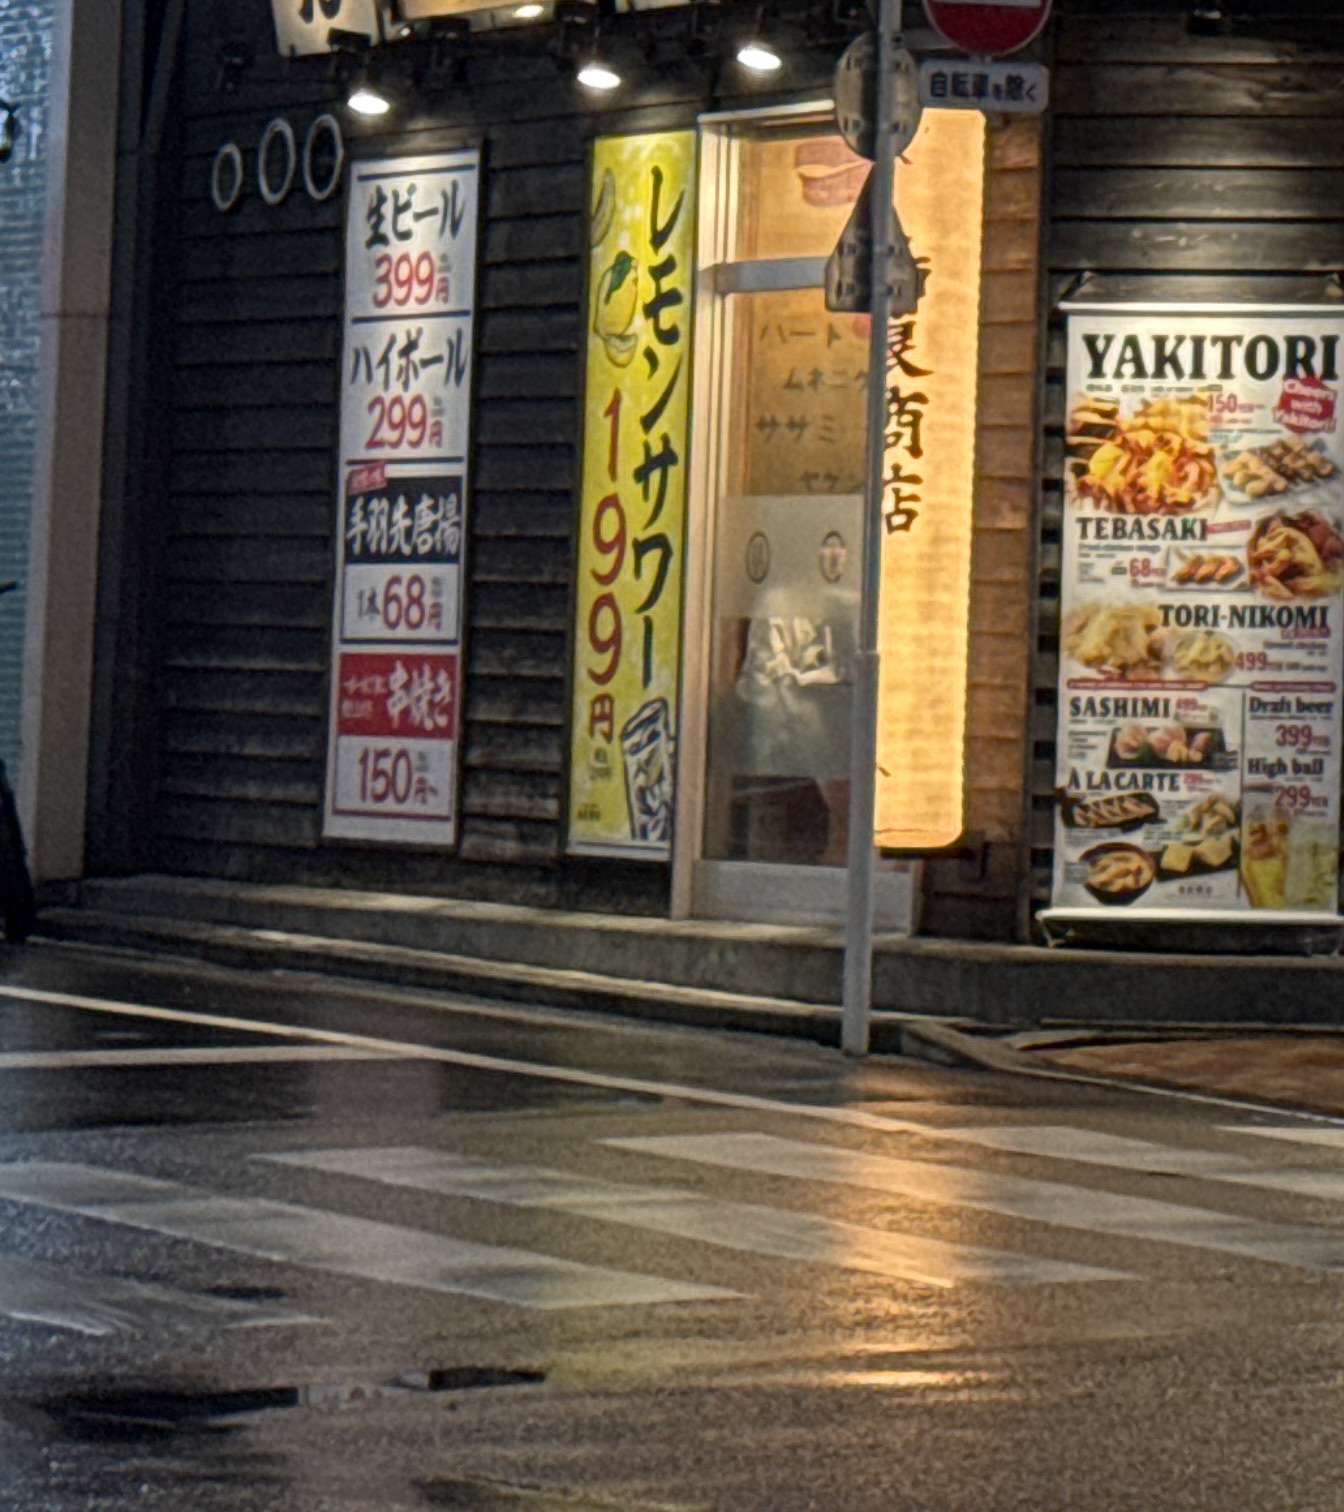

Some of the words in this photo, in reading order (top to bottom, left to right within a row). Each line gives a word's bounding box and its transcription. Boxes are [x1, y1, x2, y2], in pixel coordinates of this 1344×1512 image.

[364, 178, 468, 250] 生ビール
[350, 326, 468, 392] ハイボール
[1081, 333, 1341, 382] YAKITORI
[633, 164, 686, 690] レモンサワー
[880, 256, 935, 536] 良商店
[345, 492, 461, 556] 手羽先唐揚
[1075, 516, 1208, 541] TEBASAKI
[386, 659, 452, 731] 串焼き
[1069, 695, 1172, 719] SASHIMI
[1296, 696, 1334, 715] beer
